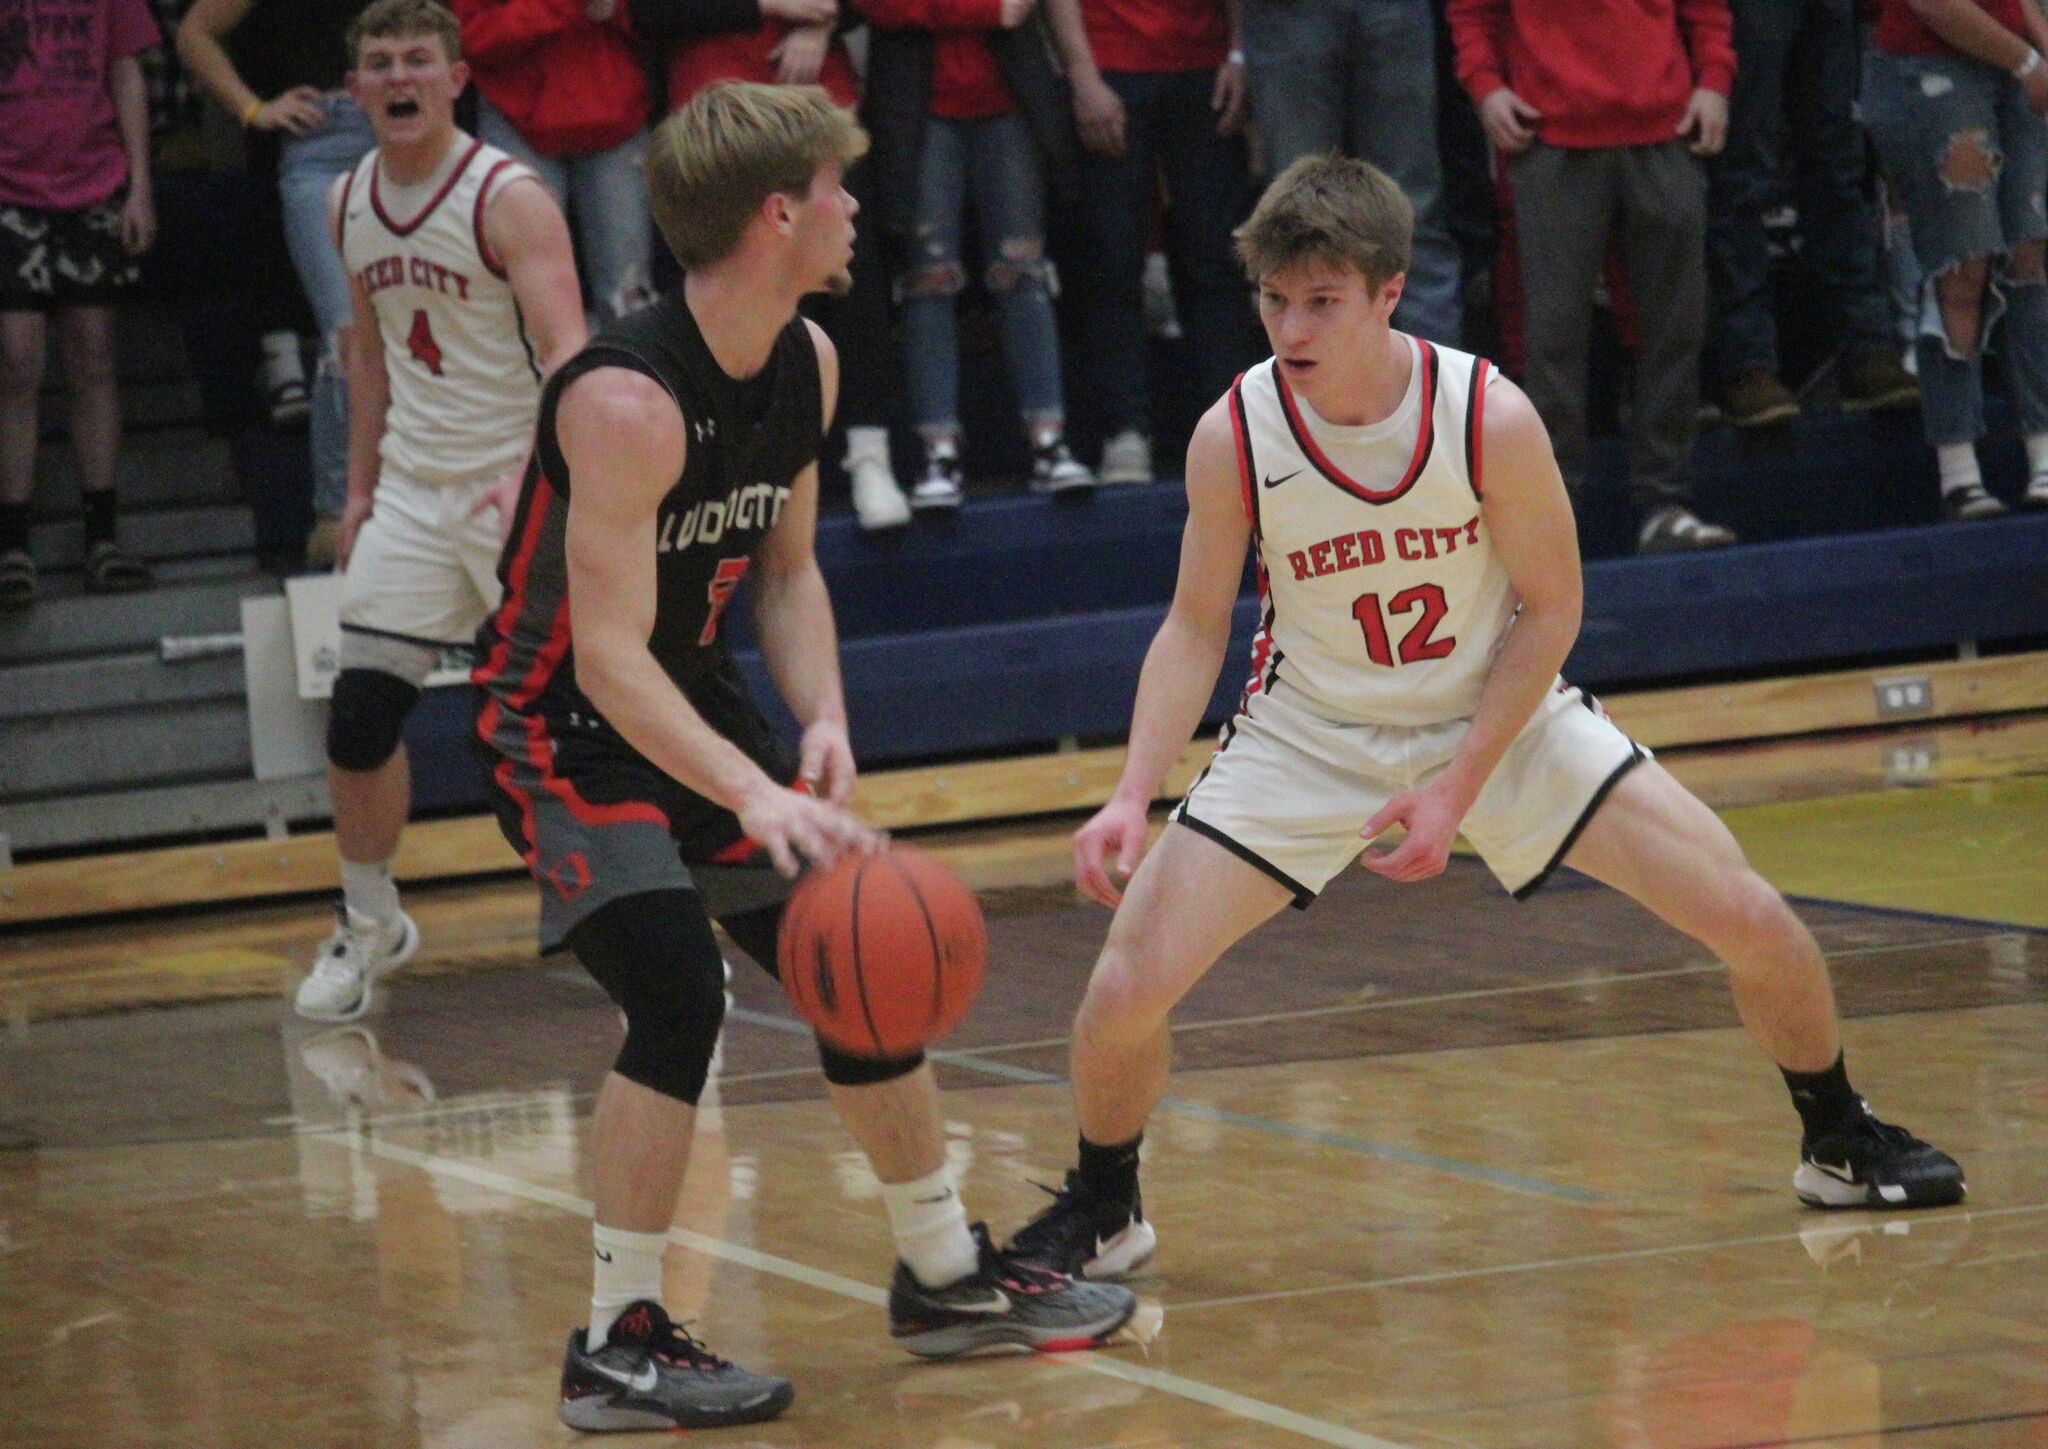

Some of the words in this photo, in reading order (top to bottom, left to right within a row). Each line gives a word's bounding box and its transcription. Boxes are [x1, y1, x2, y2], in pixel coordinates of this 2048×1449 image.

[358, 256, 404, 296] EED
[410, 256, 469, 300] CITY
[407, 308, 444, 376] 4
[1287, 529, 1386, 582] REED
[1394, 515, 1480, 562] CITY
[1352, 582, 1457, 668] 12
